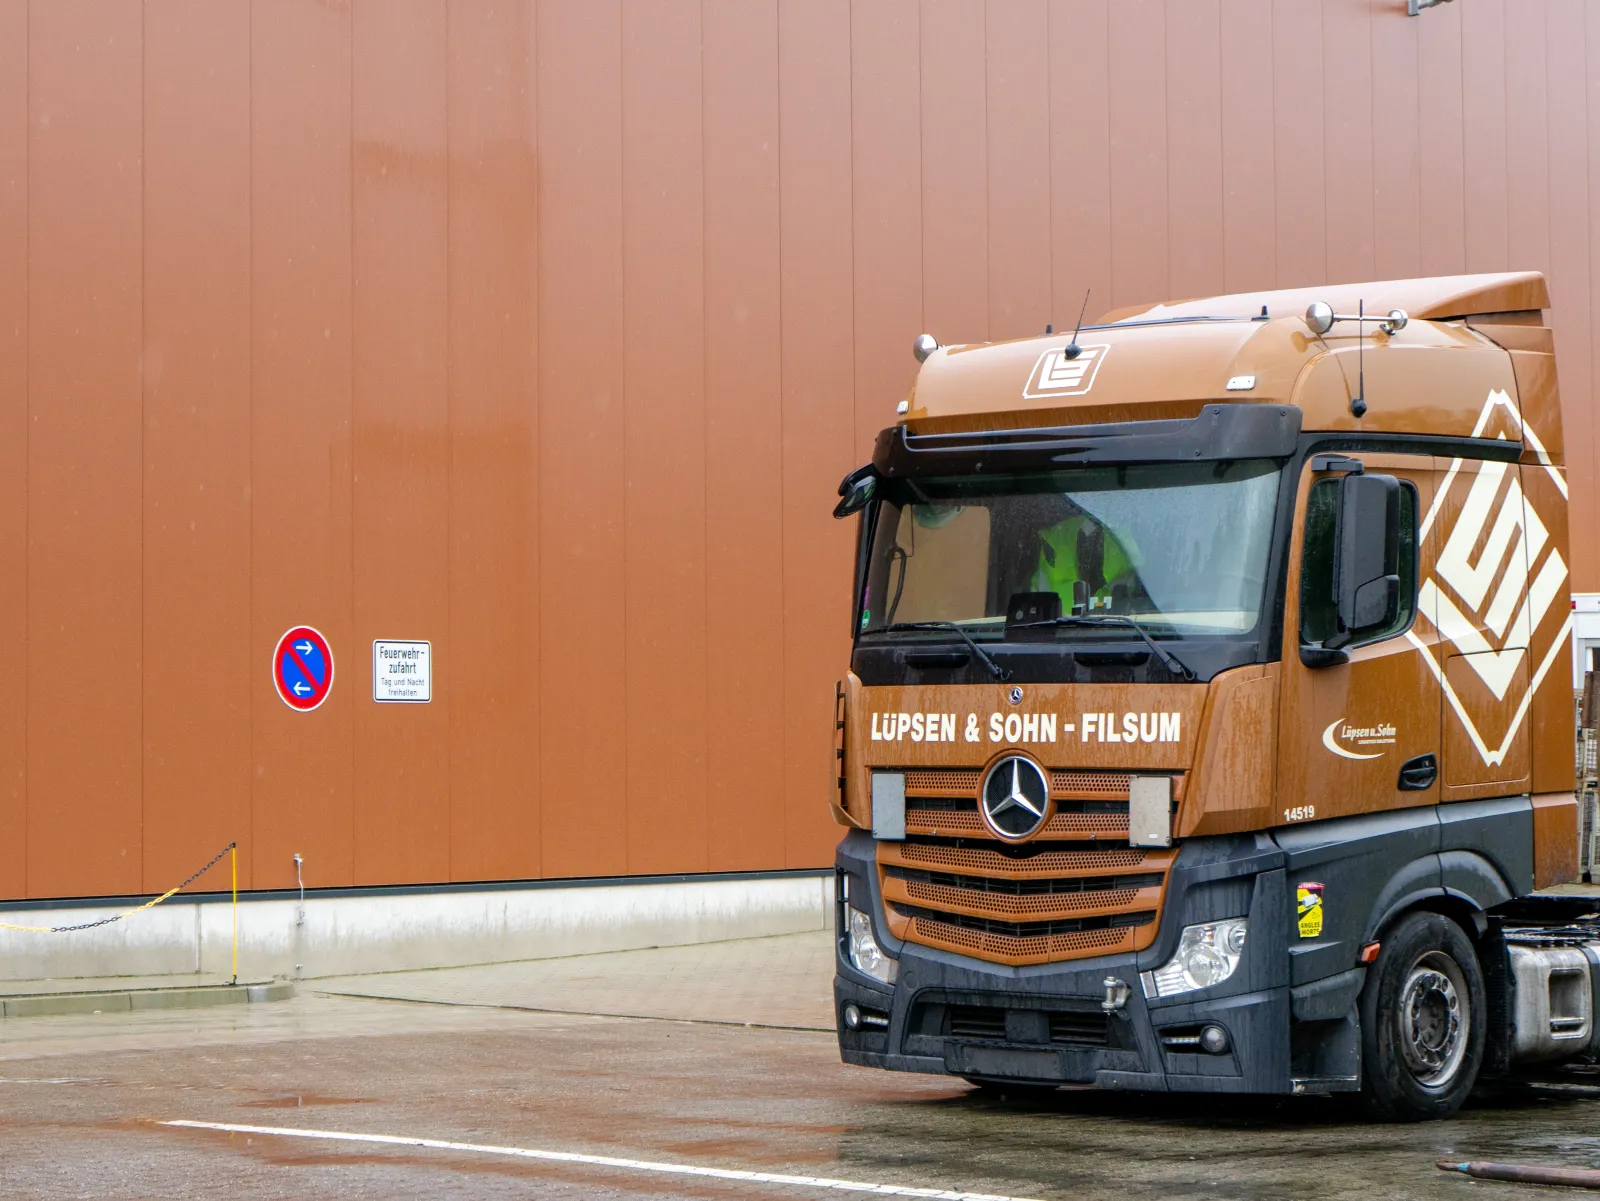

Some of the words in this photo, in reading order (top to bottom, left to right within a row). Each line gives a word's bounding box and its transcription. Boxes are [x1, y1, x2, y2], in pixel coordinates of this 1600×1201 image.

[379, 645, 425, 660] Feuerwehr-
[389, 661, 417, 674] zufahrt
[381, 677, 392, 688] Tag
[394, 678, 405, 686] und
[407, 678, 425, 686] Nacht
[388, 688, 418, 697] freihalten
[964, 712, 980, 743] &
[989, 713, 1057, 743] SOHN
[1081, 712, 1181, 743] FILSUM
[1341, 725, 1370, 741] Lüpsen
[1283, 804, 1315, 822] 14519
[1301, 921, 1321, 929] ANGLES
[1301, 928, 1320, 936] MORTS
